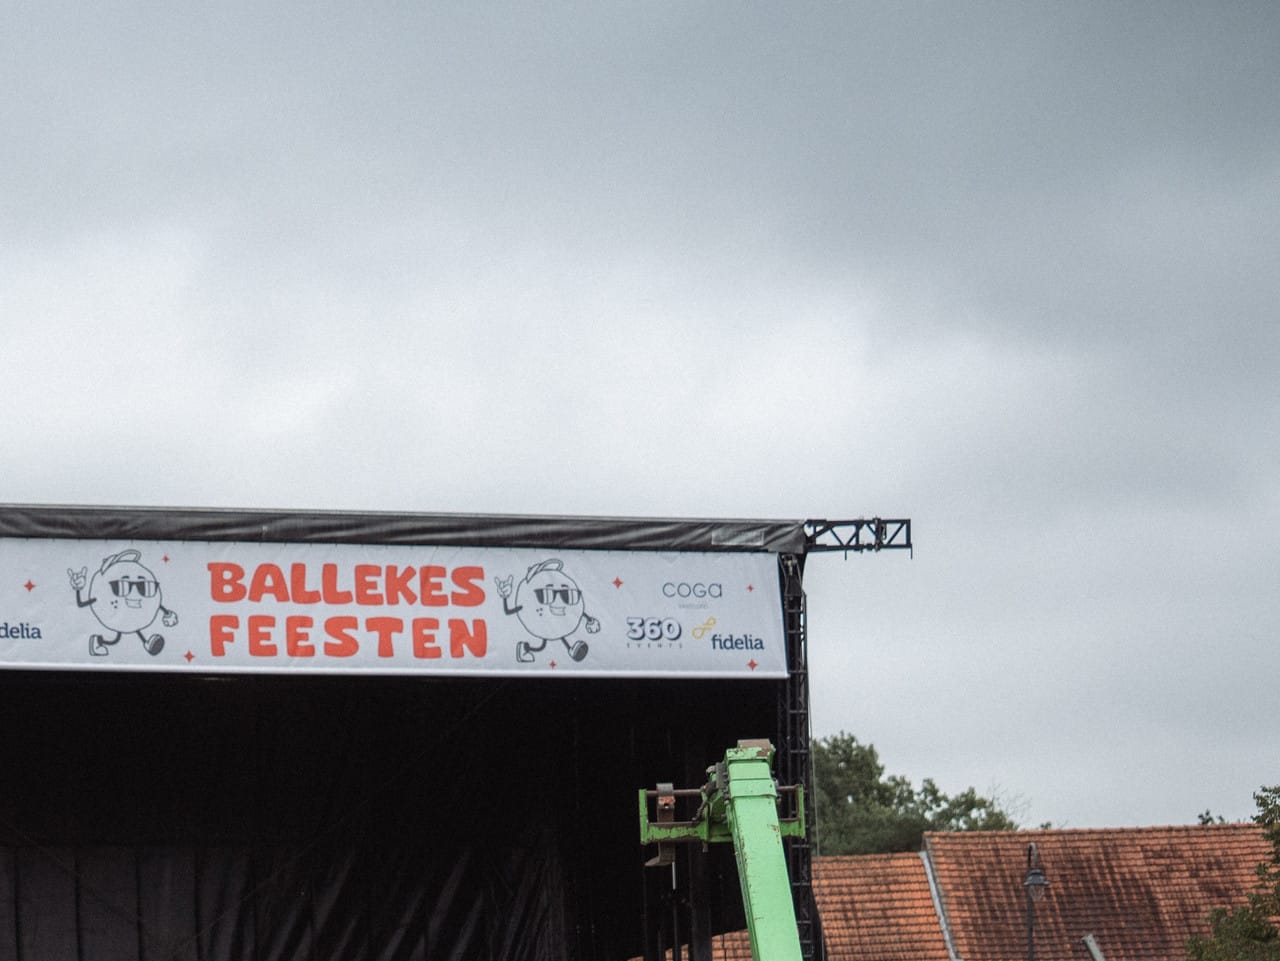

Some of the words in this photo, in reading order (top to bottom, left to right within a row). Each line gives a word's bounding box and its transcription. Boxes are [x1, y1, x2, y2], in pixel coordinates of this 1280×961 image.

[207, 562, 486, 607] BALLEKES
[210, 614, 487, 659] FEESTEN
[627, 617, 682, 641] 360
[711, 634, 764, 650] fidelia
